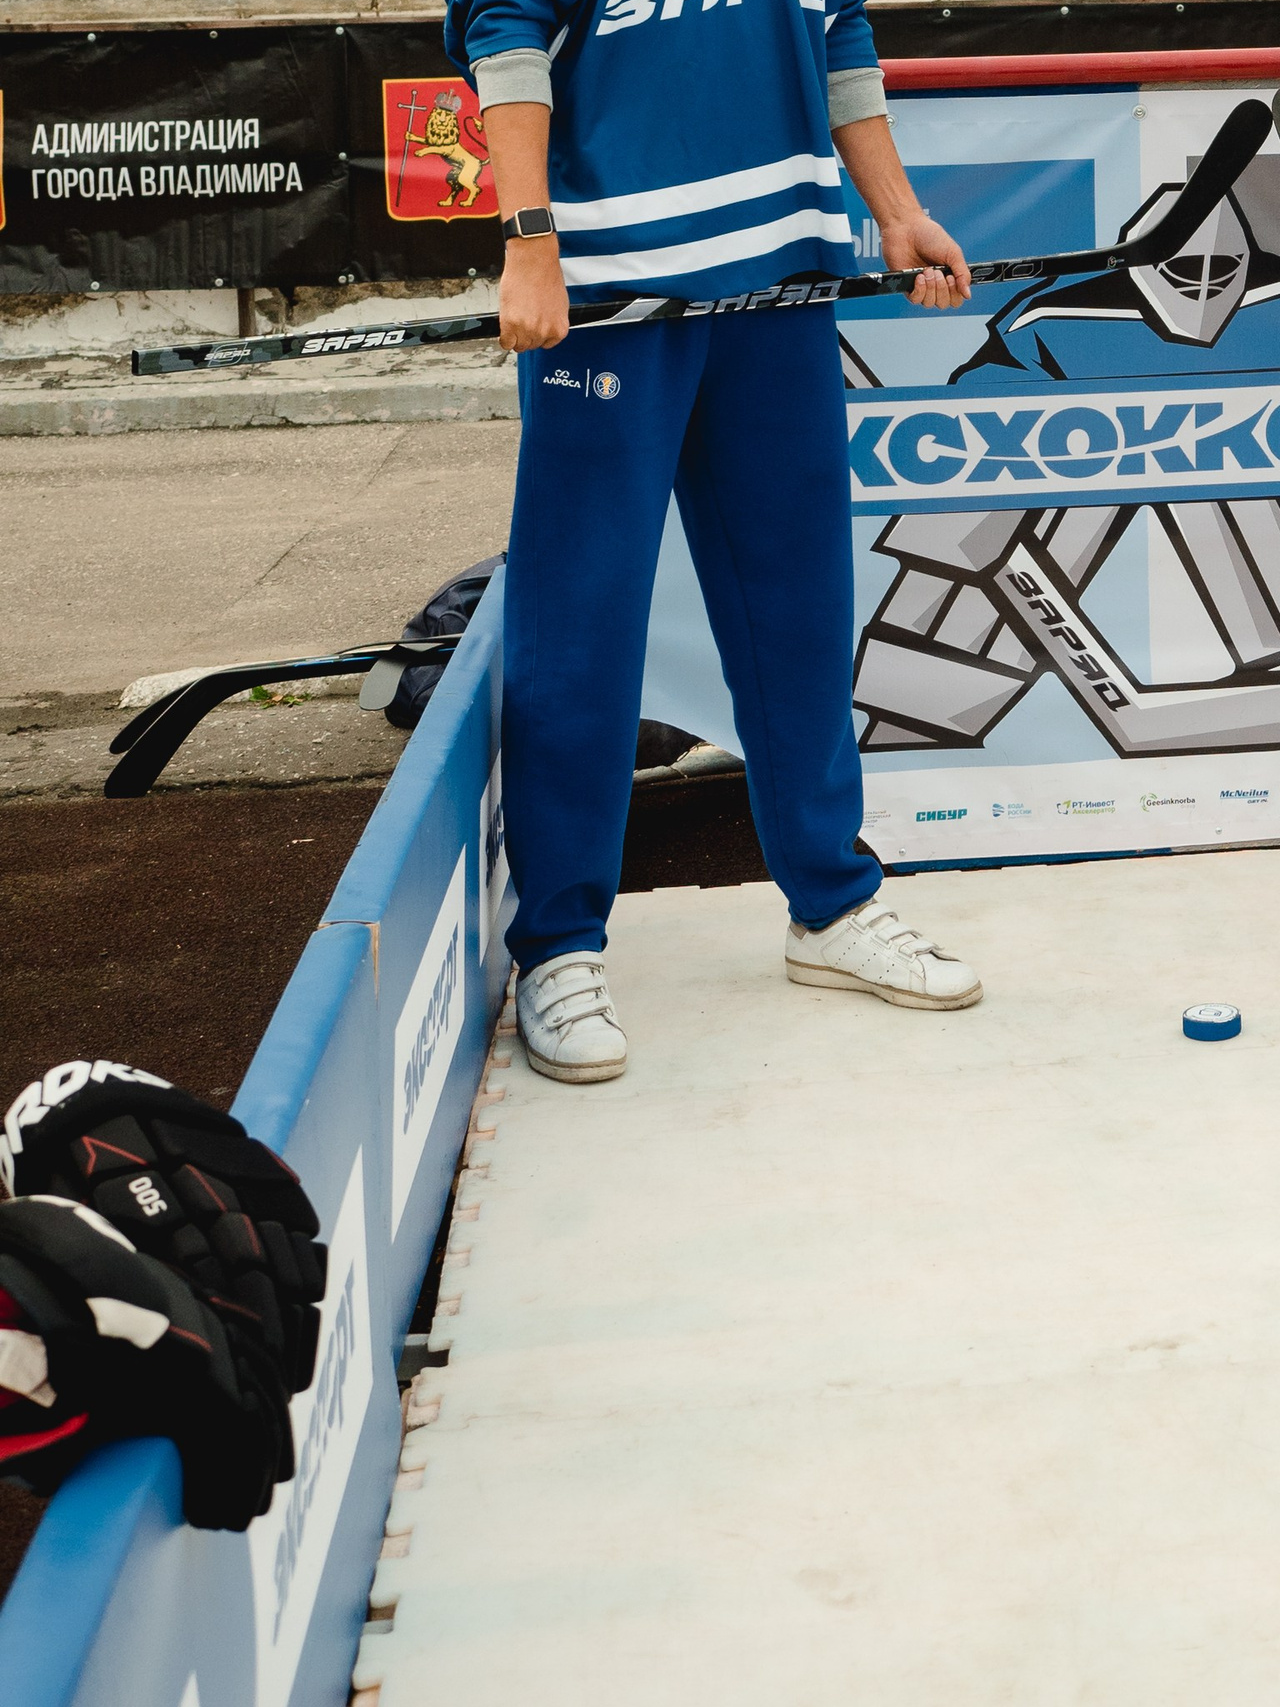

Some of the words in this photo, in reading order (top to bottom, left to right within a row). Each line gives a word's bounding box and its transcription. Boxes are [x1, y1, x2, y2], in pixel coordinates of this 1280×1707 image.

[31, 118, 260, 158] АДМИНИСТРАЦИЯ
[32, 167, 134, 201] ГОРОДА
[140, 162, 303, 198] ВЛАДИМИРА
[1220, 789, 1269, 798] McNeilus
[1072, 800, 1116, 809] РТ-Инвест
[1146, 797, 1196, 807] Geesinknorba
[916, 808, 968, 823] СИБУР
